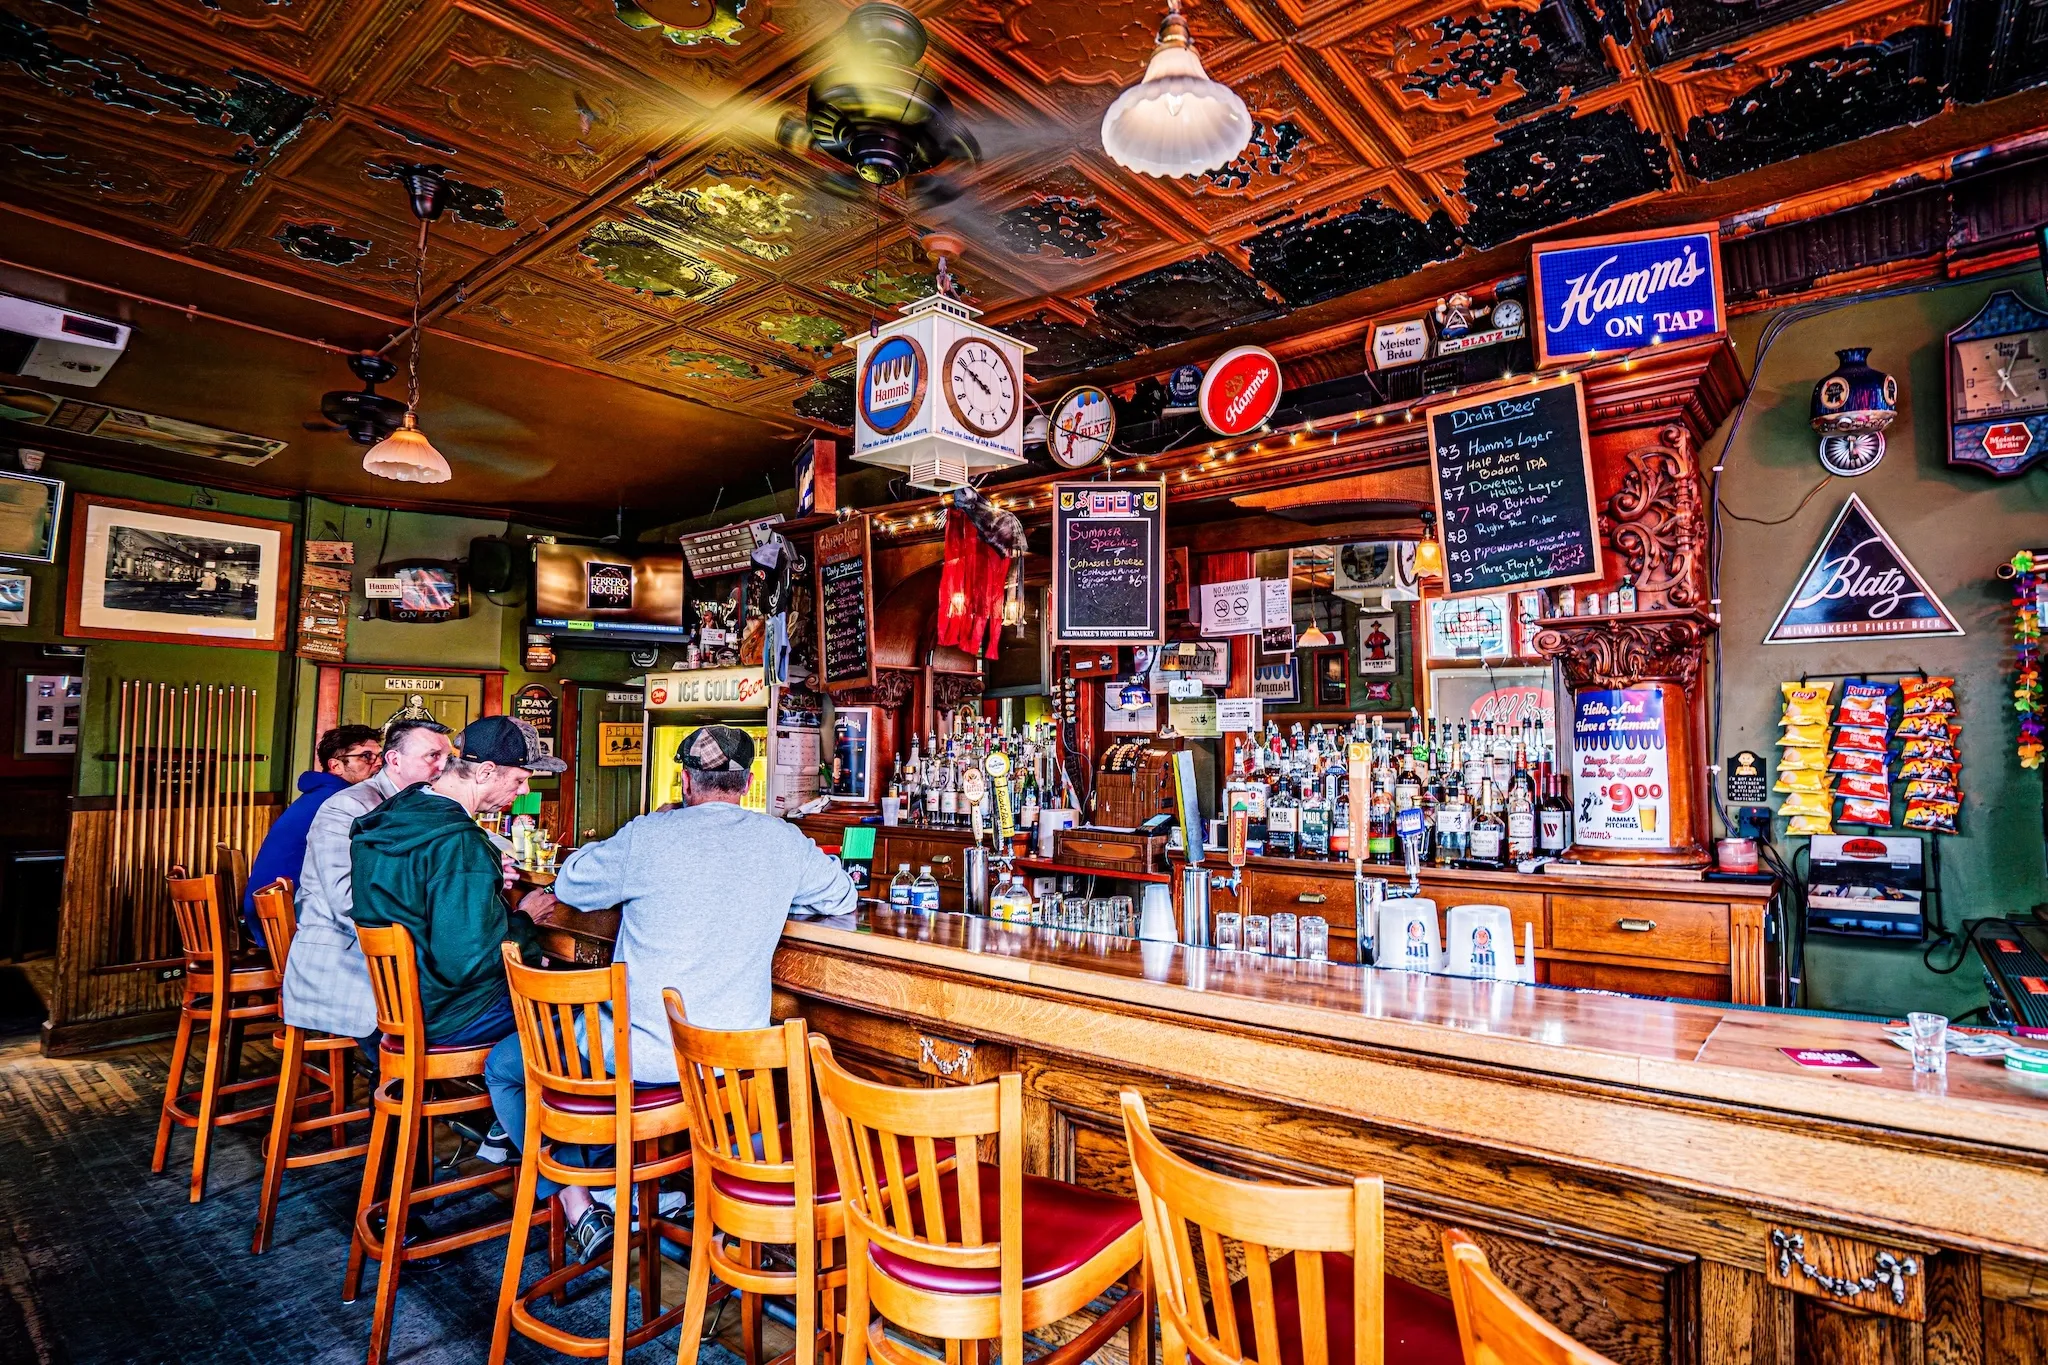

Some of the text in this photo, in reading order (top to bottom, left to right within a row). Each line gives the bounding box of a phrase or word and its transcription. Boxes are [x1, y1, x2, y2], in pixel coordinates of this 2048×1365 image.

[1548, 245, 1705, 333] Hamm's
[1605, 309, 1704, 337] ON TAP
[1380, 337, 1421, 351] Meister
[1461, 331, 1503, 348] BLATZ
[980, 349, 987, 363] 12
[993, 358, 998, 369] 1
[1180, 375, 1193, 383] Blue
[875, 382, 909, 403] Hamm's
[1177, 382, 1197, 390] Ribbon
[1002, 392, 1011, 400] 3
[1225, 366, 1270, 427] Hamm's
[980, 413, 985, 426] 6
[1451, 397, 1540, 429] Draft Beer
[880, 438, 889, 446] land
[903, 431, 912, 439] blue
[941, 426, 954, 435] From
[955, 430, 963, 438] the
[963, 432, 975, 442] land
[975, 436, 981, 444] of
[981, 438, 989, 447] sky
[990, 440, 1000, 449] blue
[1990, 435, 2025, 445] Meister
[1439, 430, 1553, 460] $3 Hamm's Lager
[1441, 452, 1520, 481] $7 Half Acre
[1526, 457, 1547, 471] IPA
[1443, 475, 1522, 502] $7 Dovetail
[1490, 478, 1564, 499] Helles Lager
[1475, 503, 1498, 519] Hop
[1502, 493, 1549, 509] Butcher
[1499, 508, 1522, 520] Grid
[1448, 522, 1504, 544] $8 Right
[1450, 549, 1471, 563] $8
[1557, 531, 1566, 540] of
[826, 558, 863, 578] Daily Specials
[1069, 557, 1145, 570] Cohasset Breeze
[1452, 555, 1543, 584] $5 Three Floyd's
[1082, 569, 1116, 577] Cohasset
[1501, 570, 1529, 583] Deluxe
[369, 582, 400, 590] Hamm's
[591, 576, 628, 587] FERRERO
[1223, 583, 1249, 593] SMOKING
[591, 585, 628, 596] ROCHER
[399, 611, 451, 619] ON TAP
[1127, 630, 1155, 638] BREWERY
[1784, 620, 1941, 635] MILWAUKEE'S FINEST BEER
[302, 645, 340, 655] ORGANIZATION
[1179, 655, 1201, 666] WITCH
[1203, 655, 1210, 665] IS
[388, 679, 442, 689] MENS ROOM
[678, 677, 699, 702] ICE
[704, 677, 739, 702] COLD
[738, 678, 764, 702] Beer
[1178, 682, 1193, 694] out
[1794, 691, 1817, 699] Lay's
[1848, 686, 1884, 696] RUFFLES
[521, 699, 553, 708] PAY
[1583, 701, 1644, 717] Hello, And
[1576, 716, 1660, 733] Have a Hamm's!
[1610, 754, 1647, 765] Football
[1598, 767, 1615, 780] Day
[1271, 811, 1287, 819] KNOB
[1303, 811, 1320, 821] KNOB
[1579, 827, 1612, 840] Hamm's
